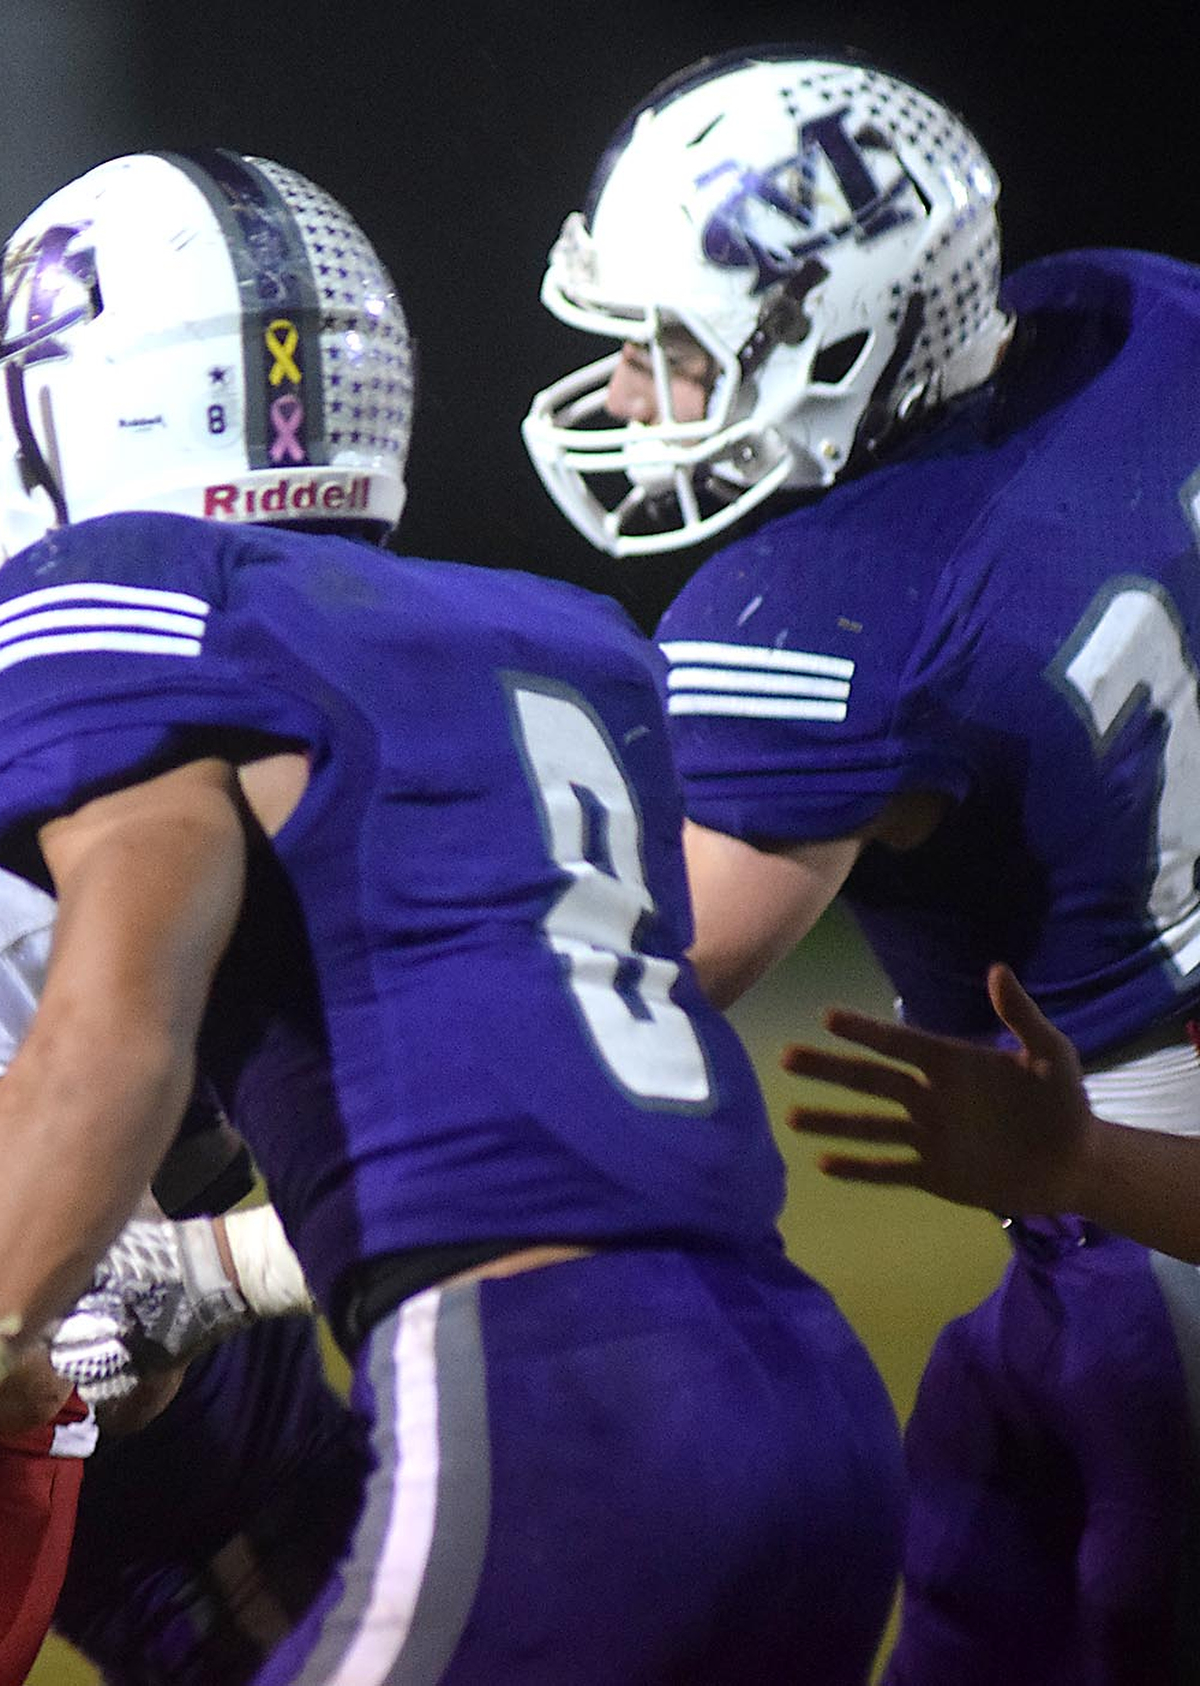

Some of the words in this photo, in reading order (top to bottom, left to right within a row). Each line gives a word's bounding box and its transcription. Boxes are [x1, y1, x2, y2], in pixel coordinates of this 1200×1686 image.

[207, 404, 227, 434] 8
[204, 476, 372, 520] Riddell
[503, 672, 714, 1110] 8
